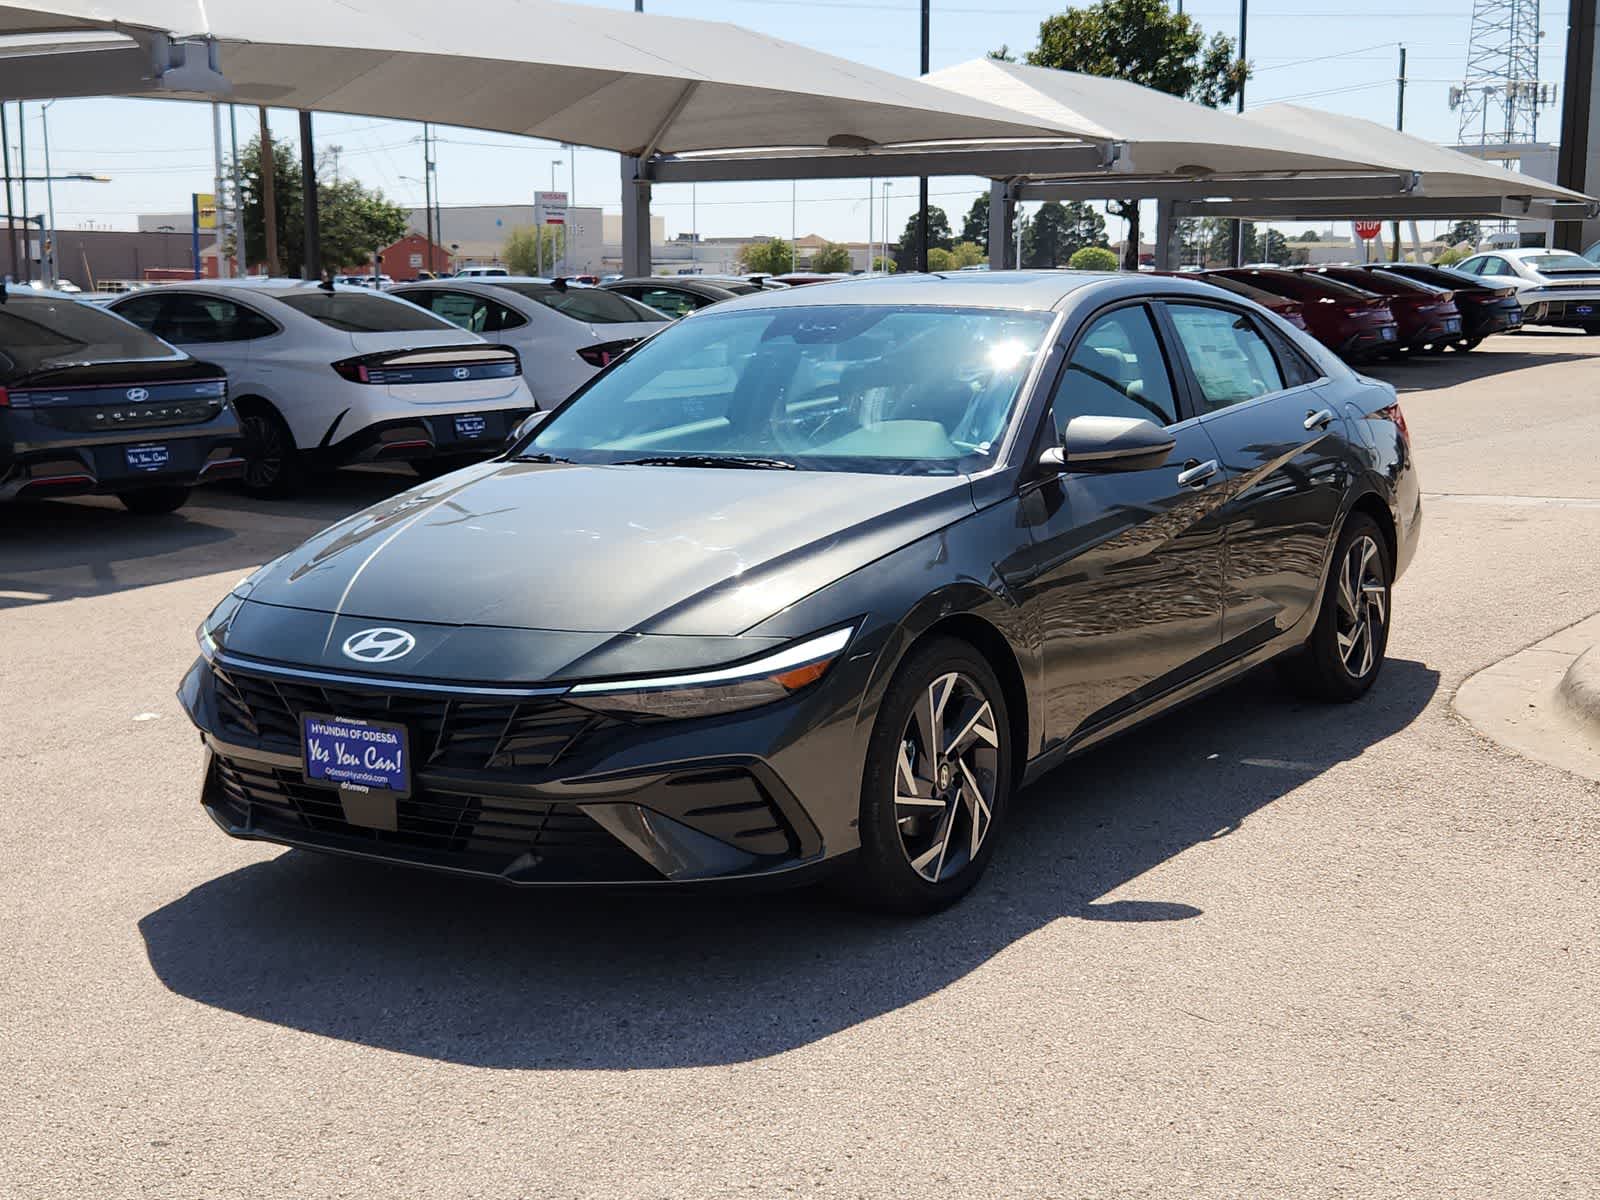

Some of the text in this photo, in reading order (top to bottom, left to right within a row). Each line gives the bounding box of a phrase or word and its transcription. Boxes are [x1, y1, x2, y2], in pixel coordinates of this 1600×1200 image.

[1356, 220, 1380, 231] STOP
[311, 723, 398, 744] HYUNDAI OF ODESSA
[308, 738, 402, 773] Yes You Can!
